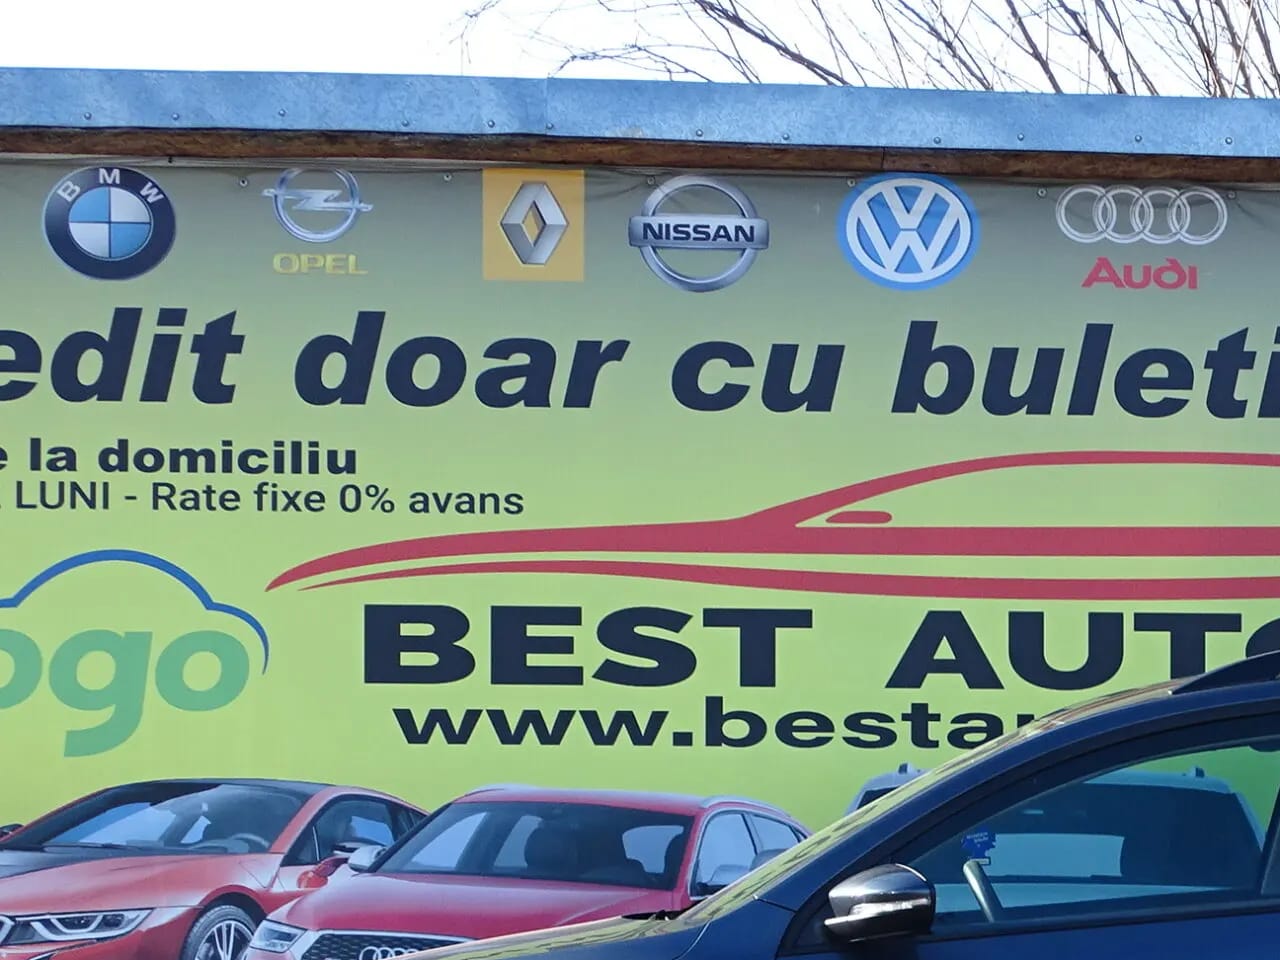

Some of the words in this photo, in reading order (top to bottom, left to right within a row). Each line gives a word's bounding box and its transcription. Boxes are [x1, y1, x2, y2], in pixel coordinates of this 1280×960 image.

[642, 222, 755, 244] NISSAN
[273, 253, 368, 275] OPEL
[1081, 257, 1198, 290] Audi
[295, 311, 630, 408] doar
[672, 342, 845, 413] cu
[30, 438, 77, 472] la
[99, 439, 356, 474] domiciliu
[16, 481, 109, 509] LUNI
[153, 483, 240, 511] Rate
[254, 482, 325, 512] fixe
[340, 485, 395, 513] 0%
[409, 493, 524, 514] avans
[364, 605, 813, 688] BEST
